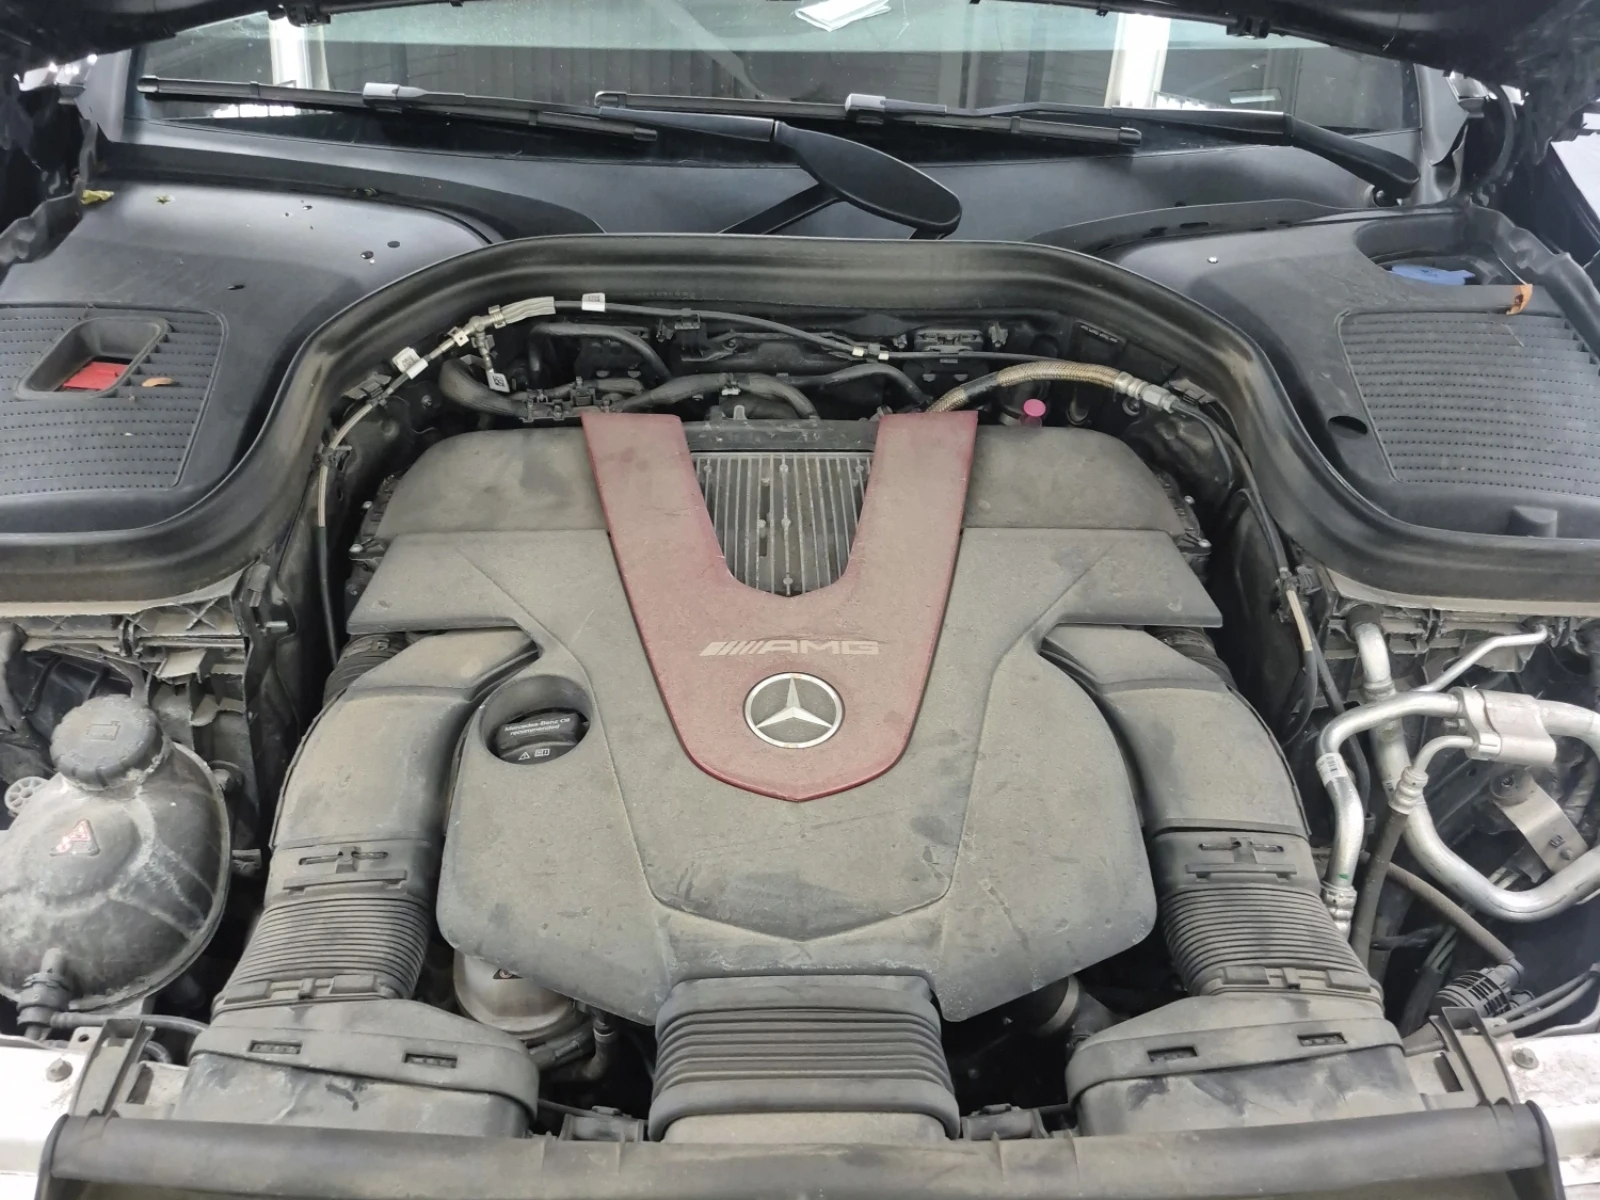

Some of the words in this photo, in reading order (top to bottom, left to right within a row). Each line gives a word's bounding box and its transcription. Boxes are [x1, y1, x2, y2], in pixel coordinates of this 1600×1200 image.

[756, 639, 880, 655] AMG
[505, 720, 559, 732] Mercedes-Benz
[510, 724, 560, 736] recommended
